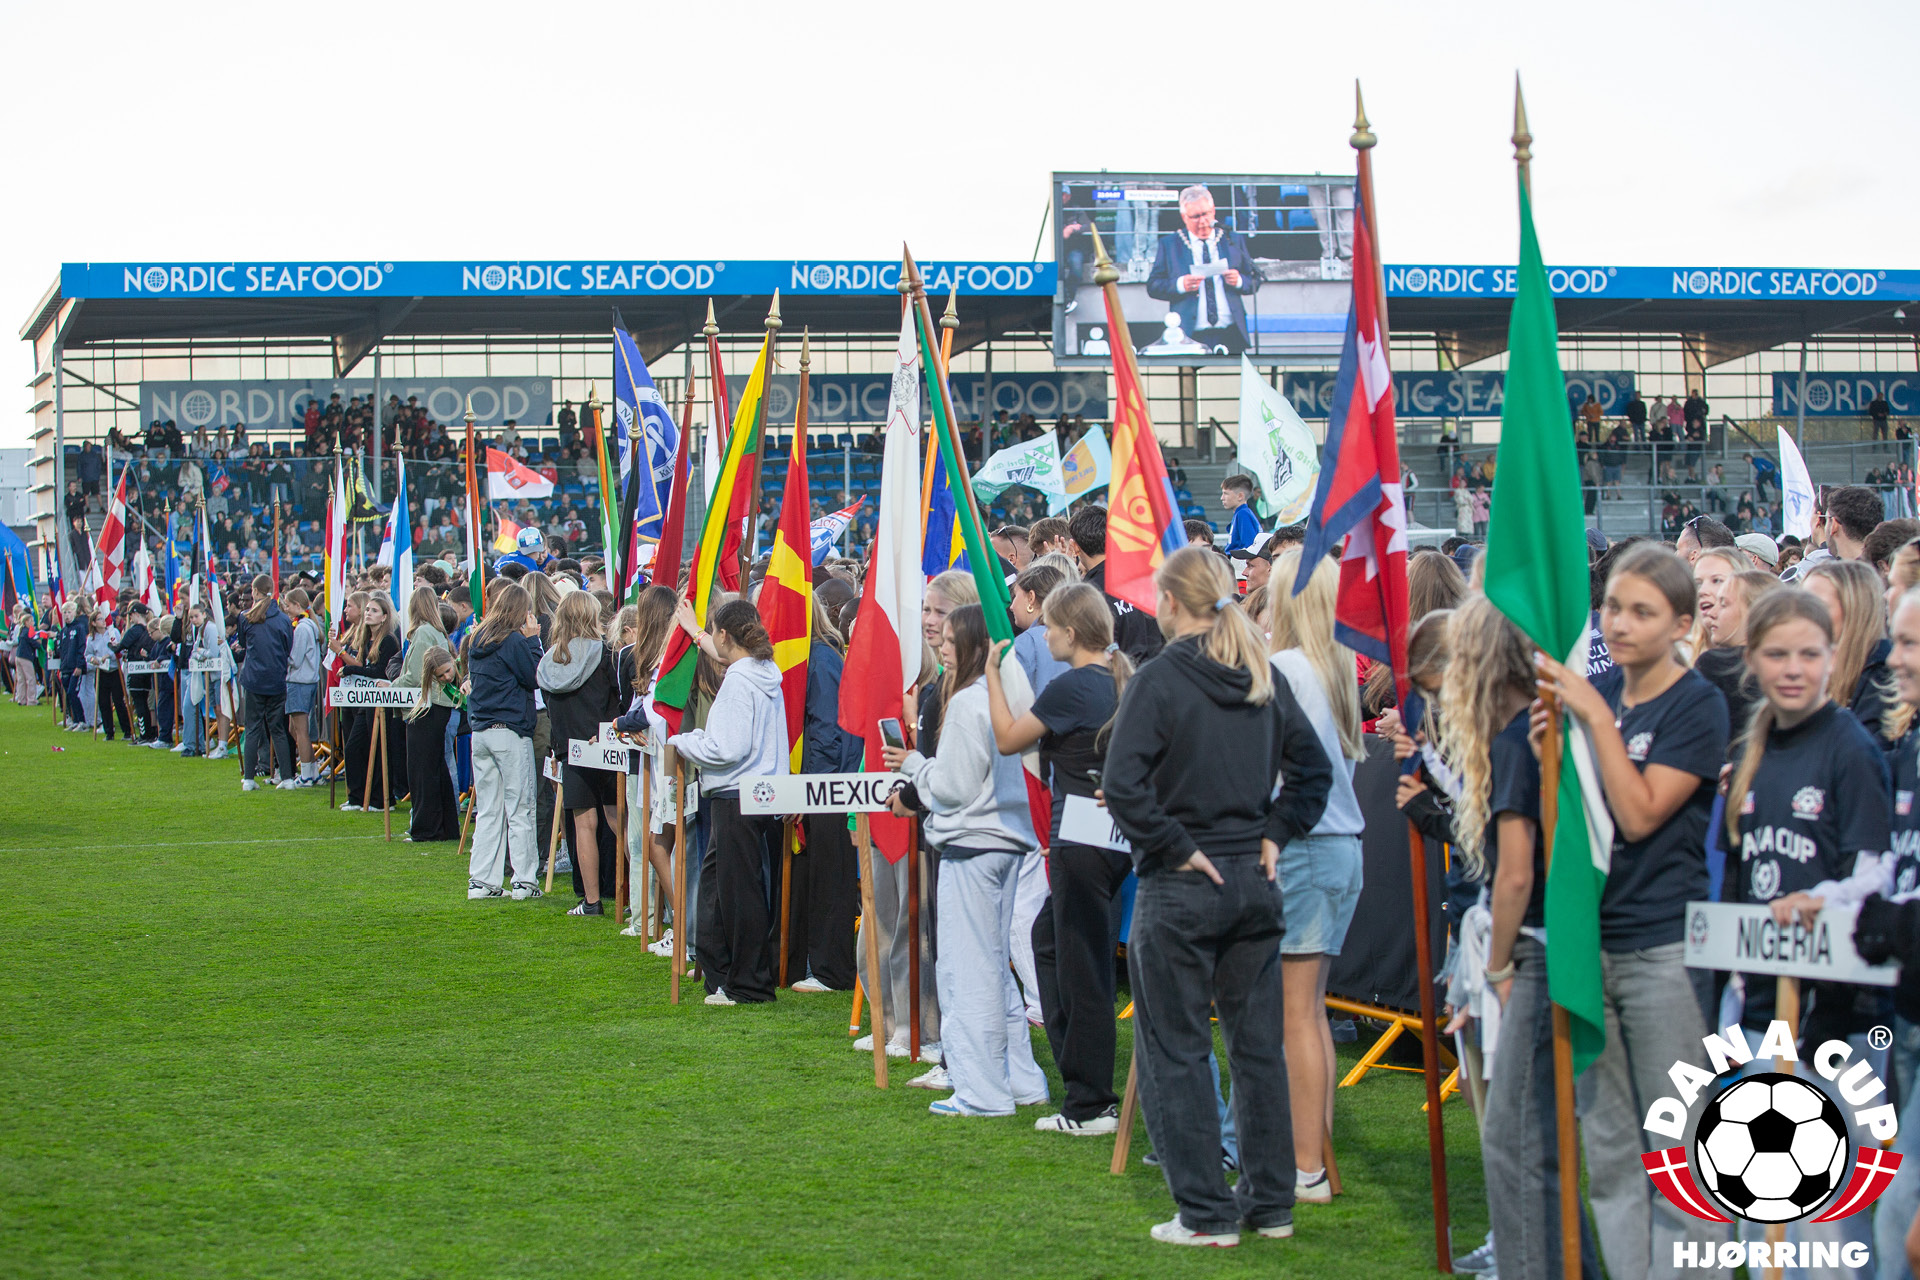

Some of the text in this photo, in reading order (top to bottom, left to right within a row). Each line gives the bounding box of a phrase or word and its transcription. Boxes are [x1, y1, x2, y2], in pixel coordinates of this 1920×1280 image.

[124, 265, 236, 293] NORDIC
[462, 265, 572, 291] NORDIC
[791, 264, 897, 290] NORDIC
[1388, 268, 1484, 293] NORDIC
[1672, 271, 1763, 294] NORDIC
[152, 388, 314, 425] NORDIC
[1781, 379, 1909, 412] NORDIC
[347, 690, 414, 704] GUATAMALA
[1775, 827, 1817, 864] CUP
[1737, 917, 1832, 965] NIGERIA
